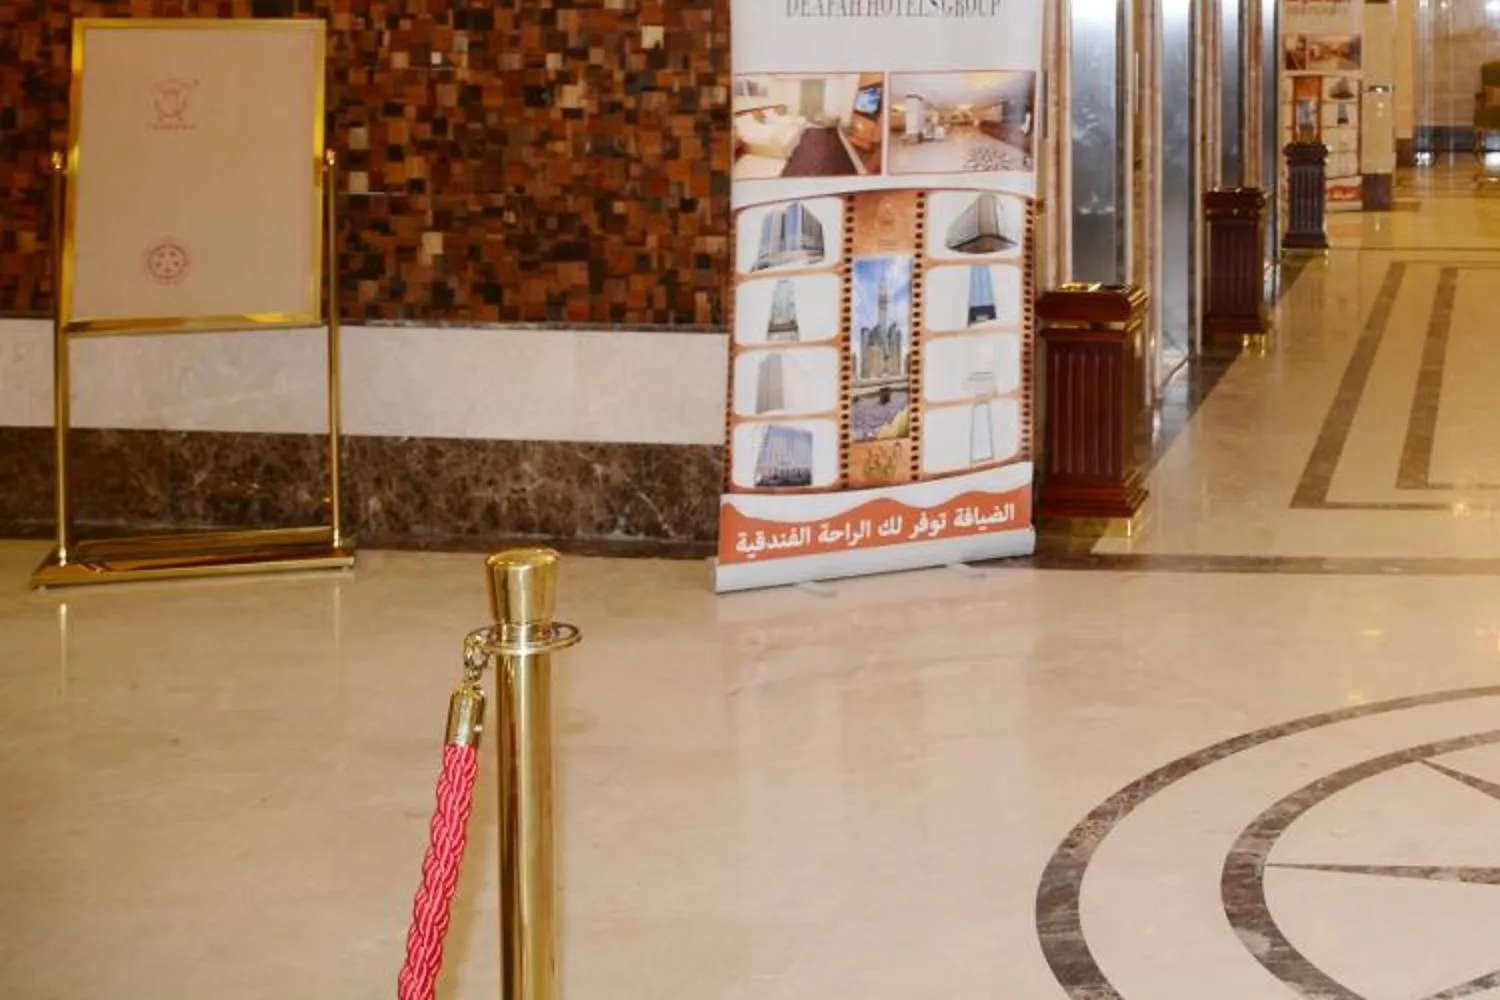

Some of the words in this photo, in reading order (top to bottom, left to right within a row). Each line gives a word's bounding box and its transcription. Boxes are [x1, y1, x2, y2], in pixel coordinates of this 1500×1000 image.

[877, 515, 903, 537] لك
[908, 513, 947, 540] توفر
[953, 503, 1015, 533] الضيافة
[735, 527, 811, 559] الفندقية
[817, 519, 871, 548] الراحة
